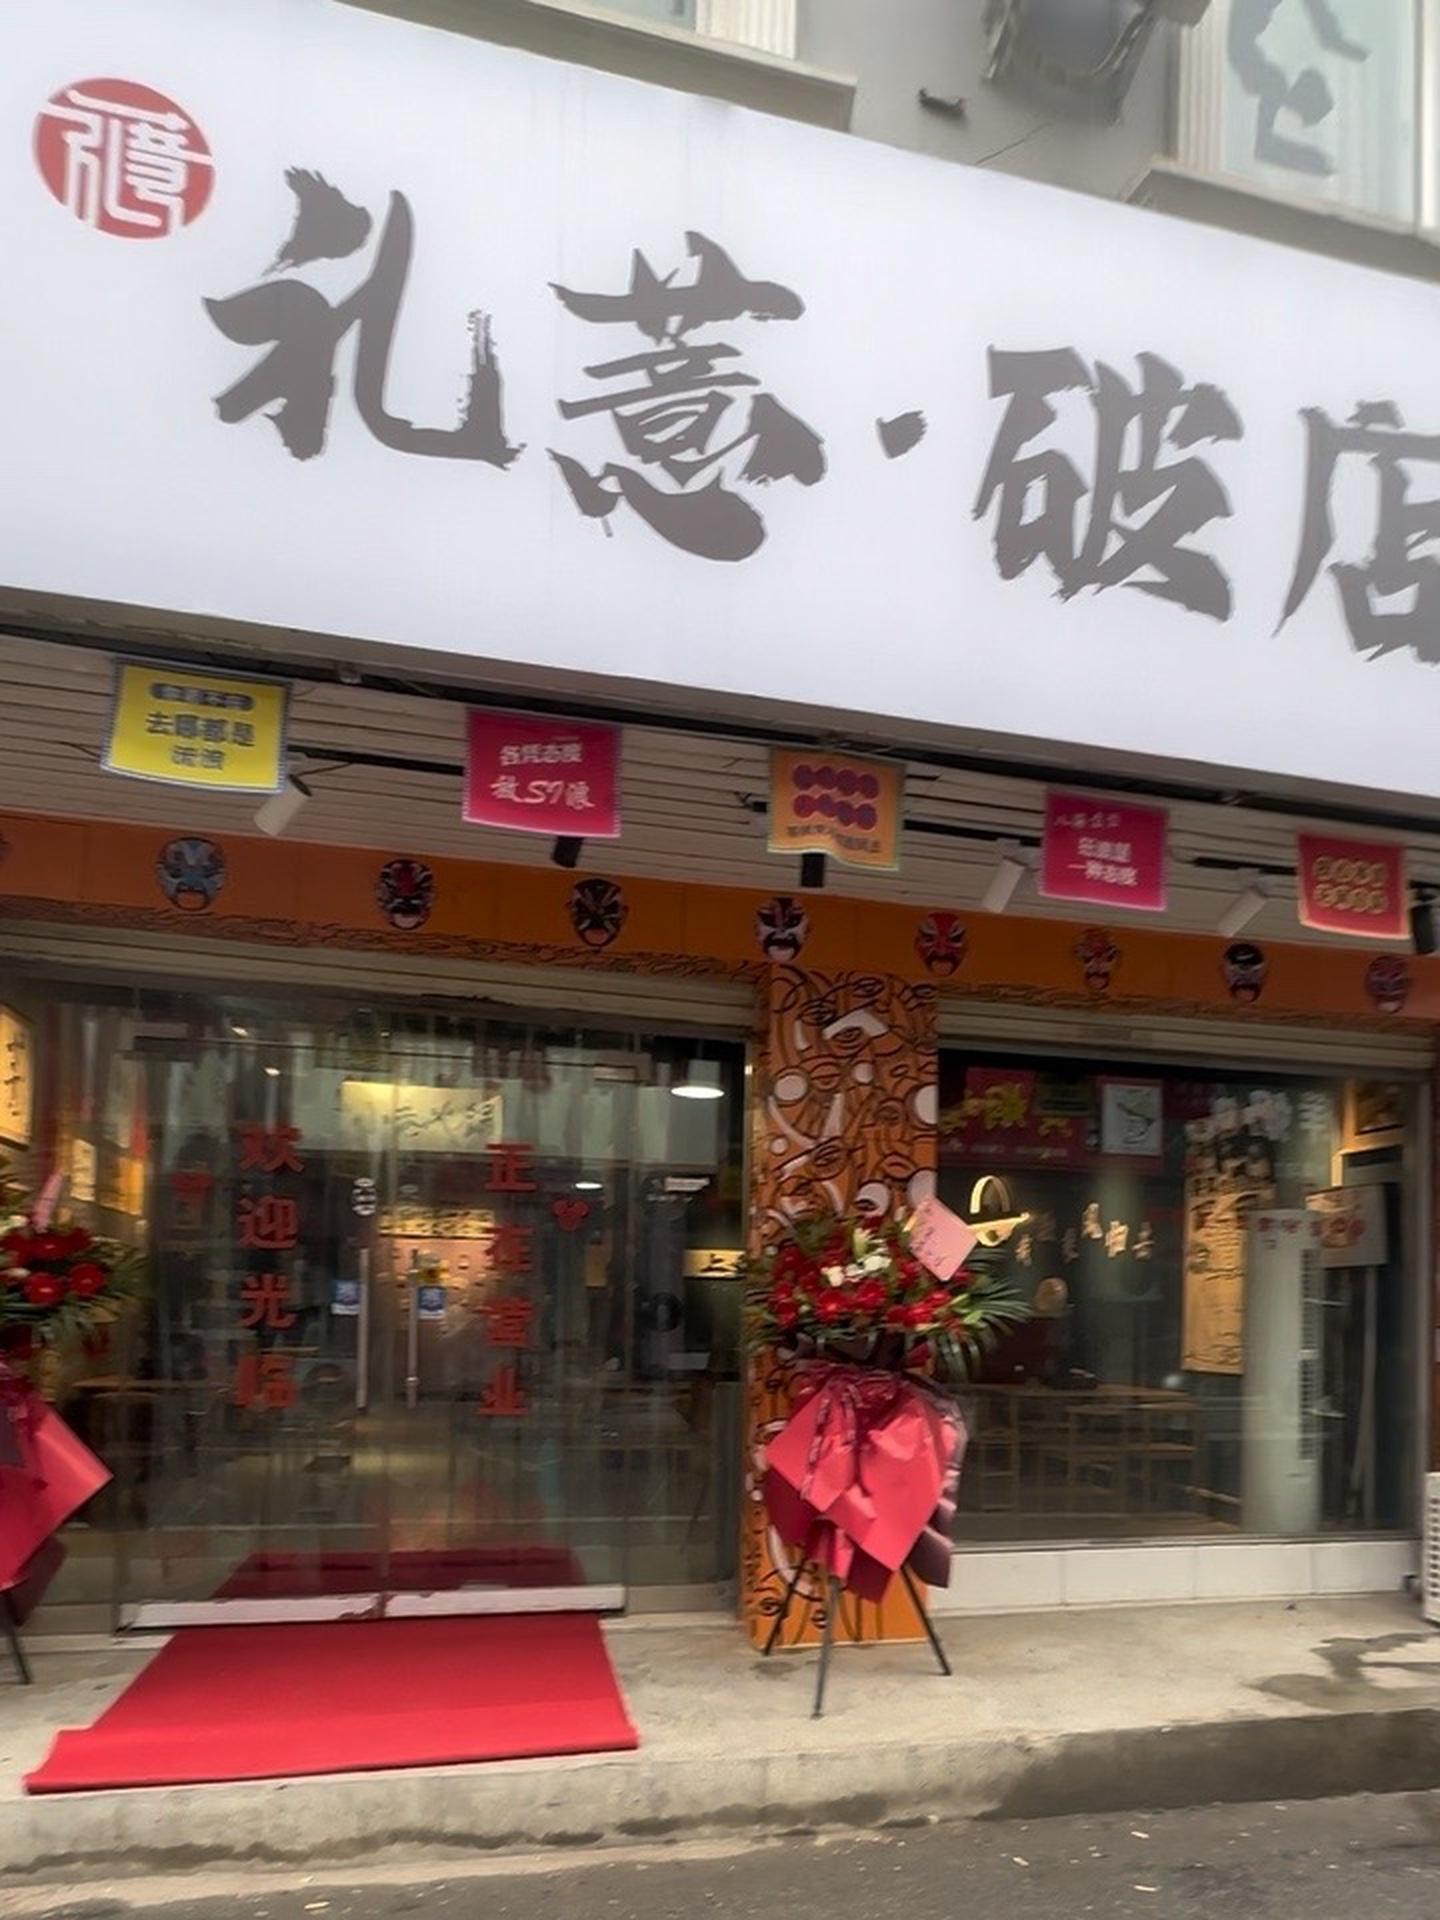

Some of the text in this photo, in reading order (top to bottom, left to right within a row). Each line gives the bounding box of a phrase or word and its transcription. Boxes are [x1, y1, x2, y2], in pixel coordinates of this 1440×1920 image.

[236, 1121, 304, 1410] 欢迎光临
[478, 1142, 538, 1418] 正在营业
